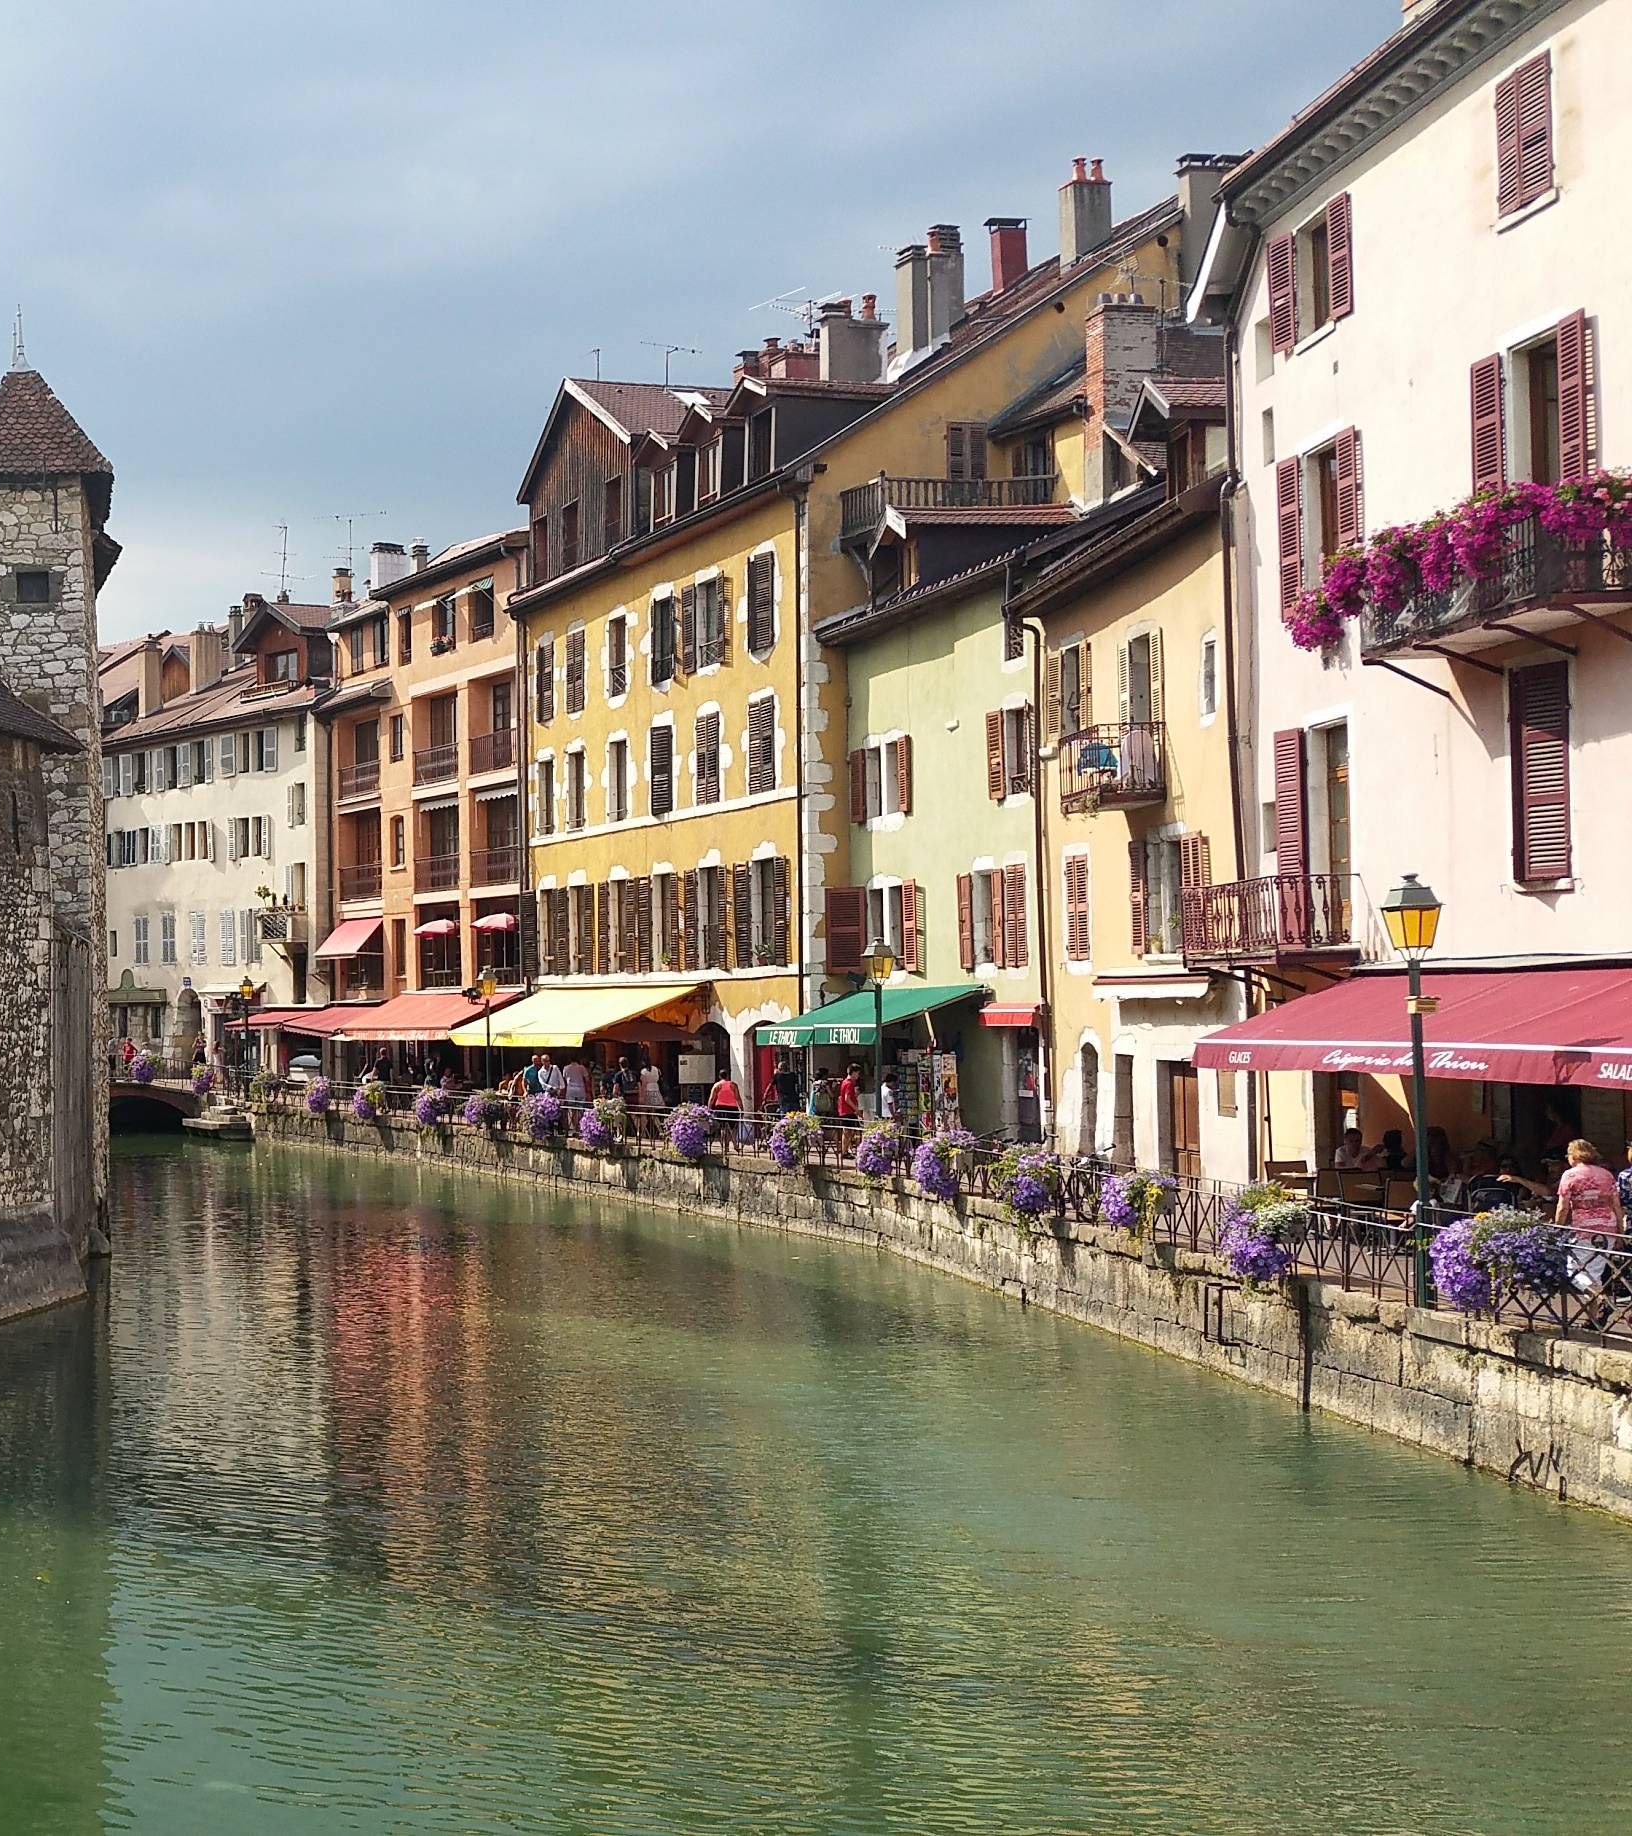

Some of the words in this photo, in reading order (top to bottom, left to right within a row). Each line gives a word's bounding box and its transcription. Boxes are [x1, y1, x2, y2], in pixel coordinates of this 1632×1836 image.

[769, 1031, 779, 1045] LE
[778, 1031, 798, 1045] THIOU
[829, 1029, 838, 1043] LE
[838, 1028, 860, 1043] THIOU
[1229, 1051, 1252, 1064] GLACES
[1321, 1049, 1392, 1070] Crêperie
[1428, 1050, 1489, 1071] Thiou
